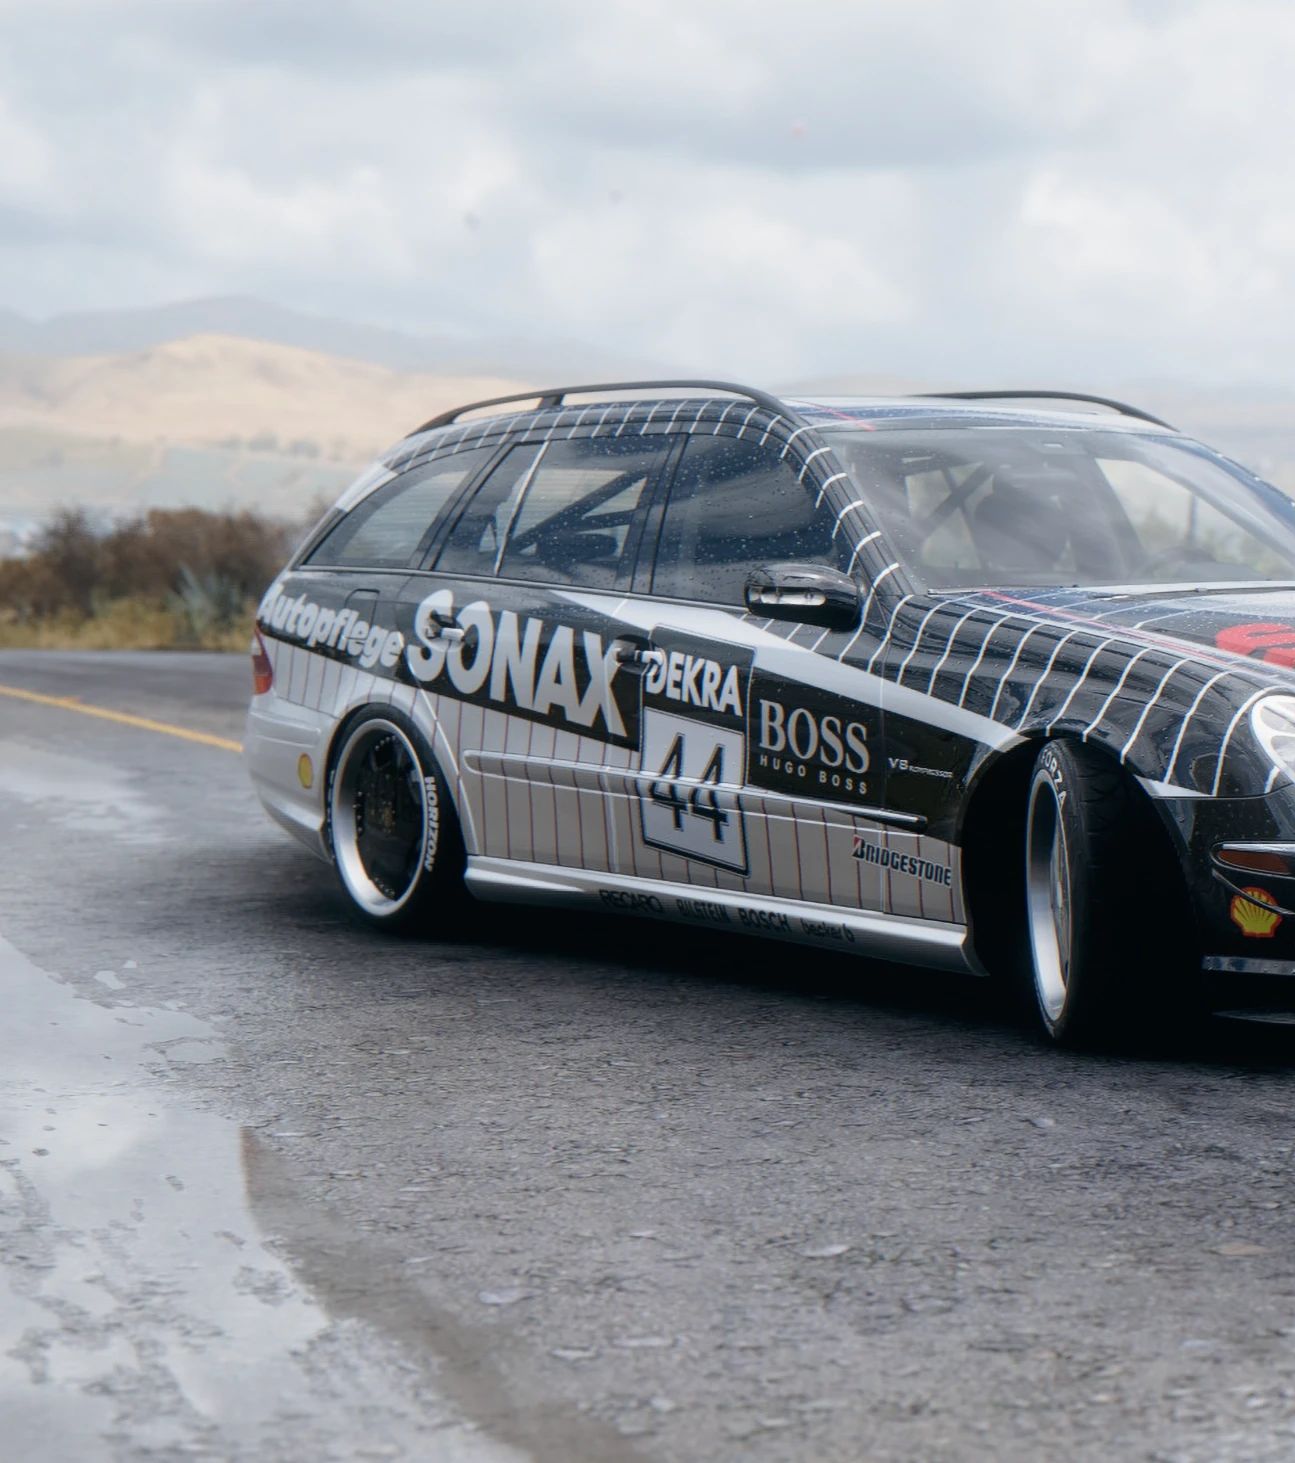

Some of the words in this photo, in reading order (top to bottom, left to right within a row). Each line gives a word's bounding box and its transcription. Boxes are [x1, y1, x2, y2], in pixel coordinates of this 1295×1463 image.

[256, 582, 404, 668] Autopflege
[406, 589, 628, 738] SONAX
[641, 649, 744, 717] DEKRA
[759, 699, 870, 774] BOSS
[650, 732, 729, 844] 44
[760, 755, 807, 778] HUGO
[819, 771, 868, 795] BOSS
[424, 776, 440, 872] HORIZON
[851, 836, 953, 887] BRIDGESTONE
[599, 889, 664, 914] RECARO
[676, 898, 732, 924] BILSTEIN
[738, 907, 793, 933] BOSCH
